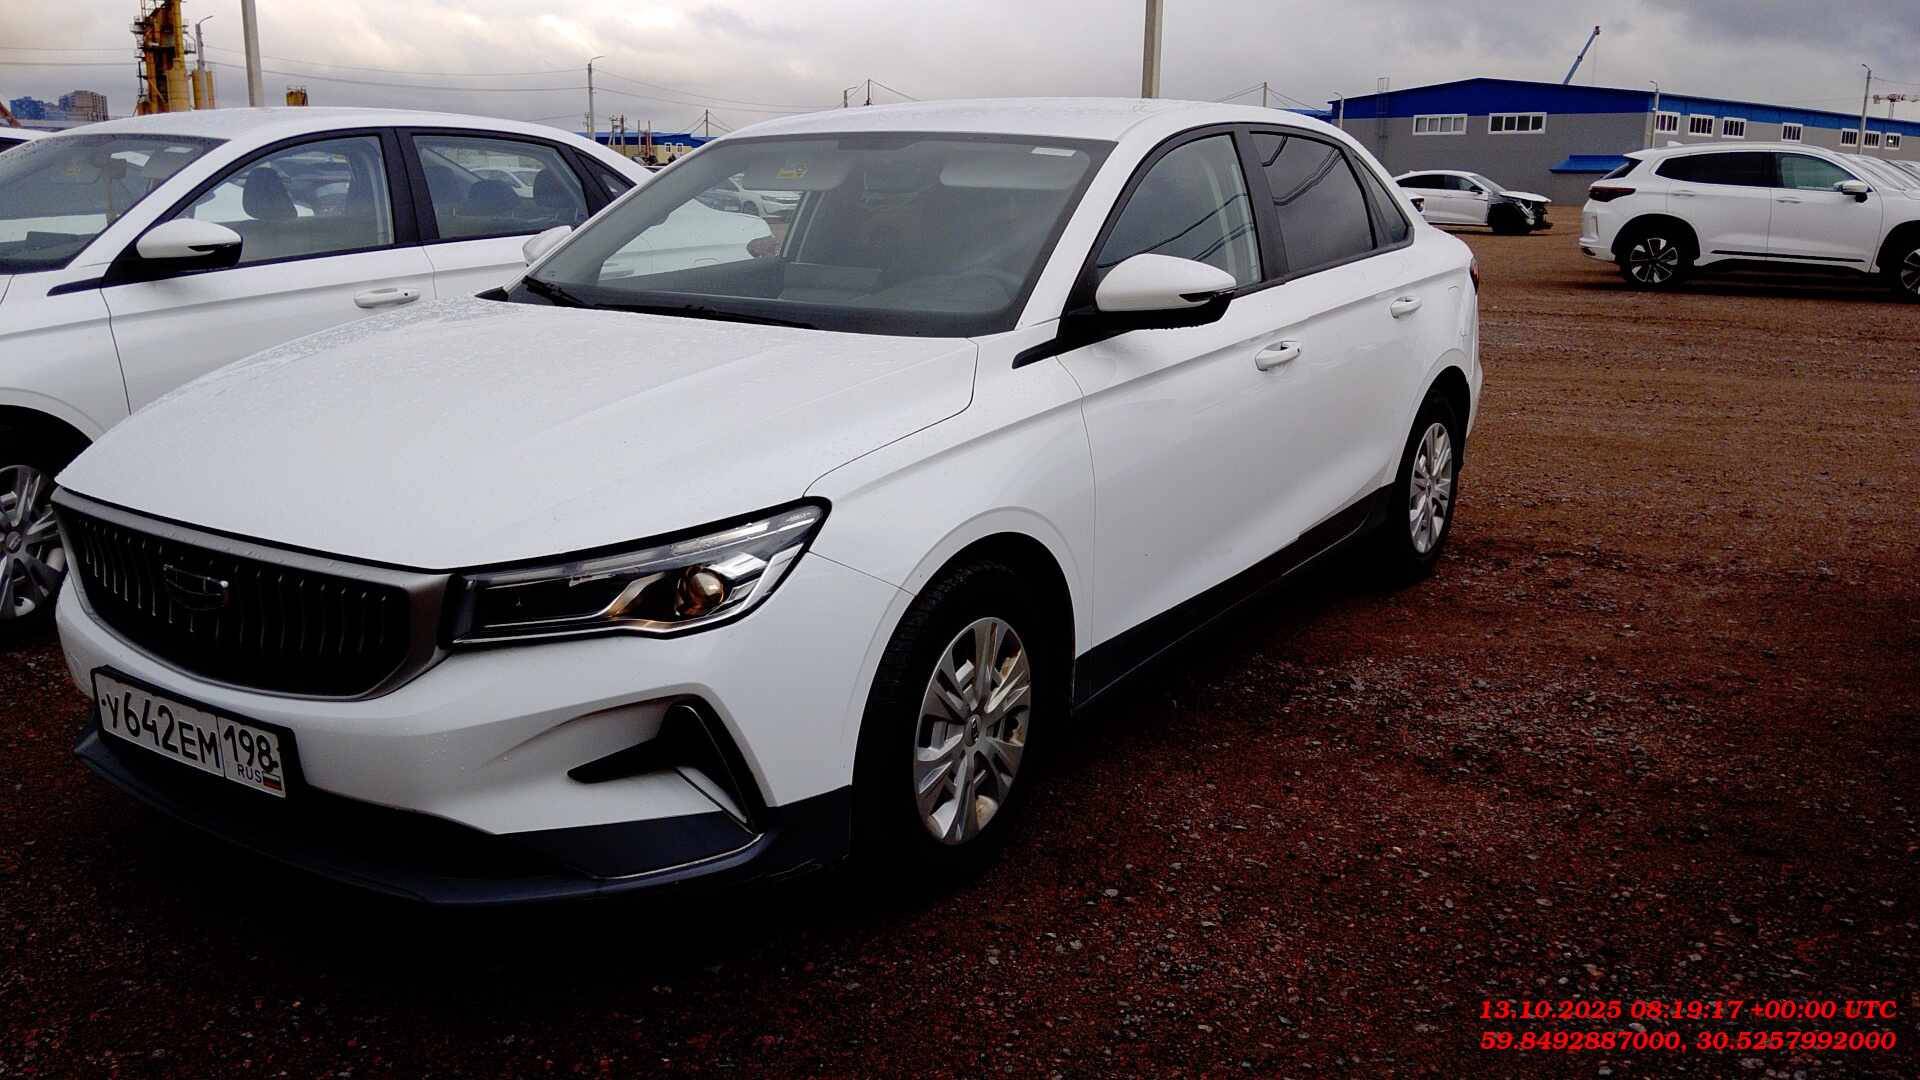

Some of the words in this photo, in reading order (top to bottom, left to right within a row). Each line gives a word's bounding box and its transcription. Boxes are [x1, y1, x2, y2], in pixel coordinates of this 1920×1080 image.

[105, 691, 221, 769] У642ЕМ
[223, 724, 275, 774] 198
[237, 764, 263, 783] RUS
